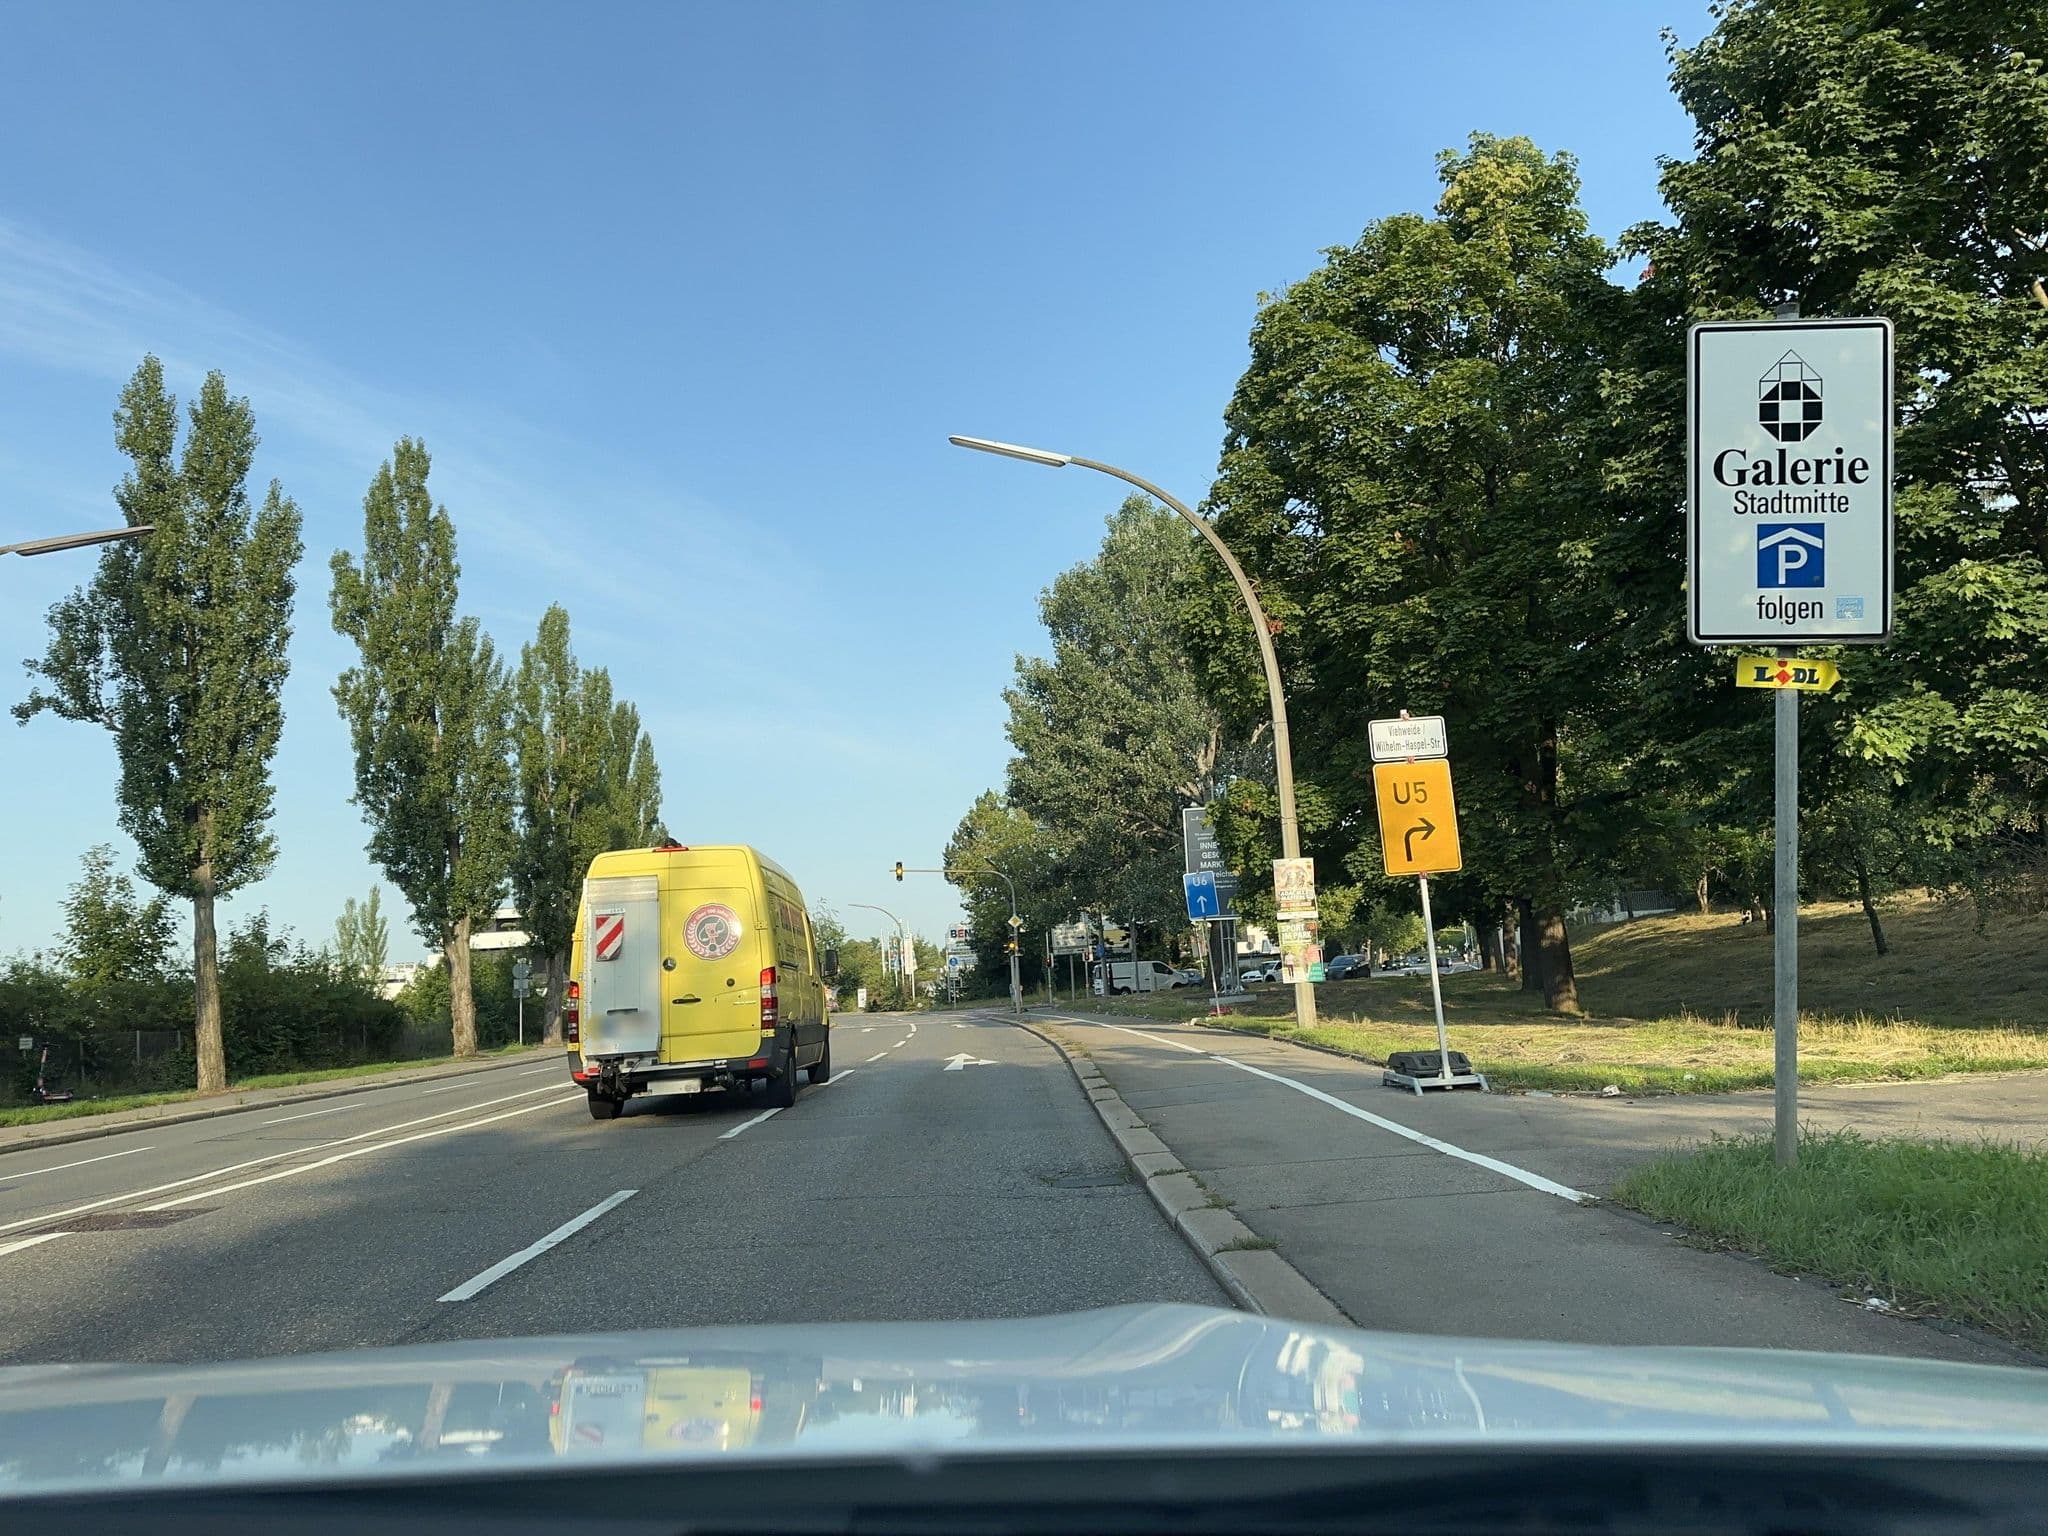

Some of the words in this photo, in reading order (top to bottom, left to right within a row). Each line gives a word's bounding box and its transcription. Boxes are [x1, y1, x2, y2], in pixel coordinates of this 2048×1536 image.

[1713, 446, 1870, 488] Galerie
[1733, 489, 1849, 515] Stadtmitte
[1778, 544, 1808, 585] P
[1756, 595, 1823, 625] folgen
[1388, 724, 1421, 736] Viehweide
[1393, 781, 1428, 804] U5
[1199, 841, 1221, 849] INNE
[1192, 875, 1208, 887] U6
[1293, 930, 1312, 940] PARK
